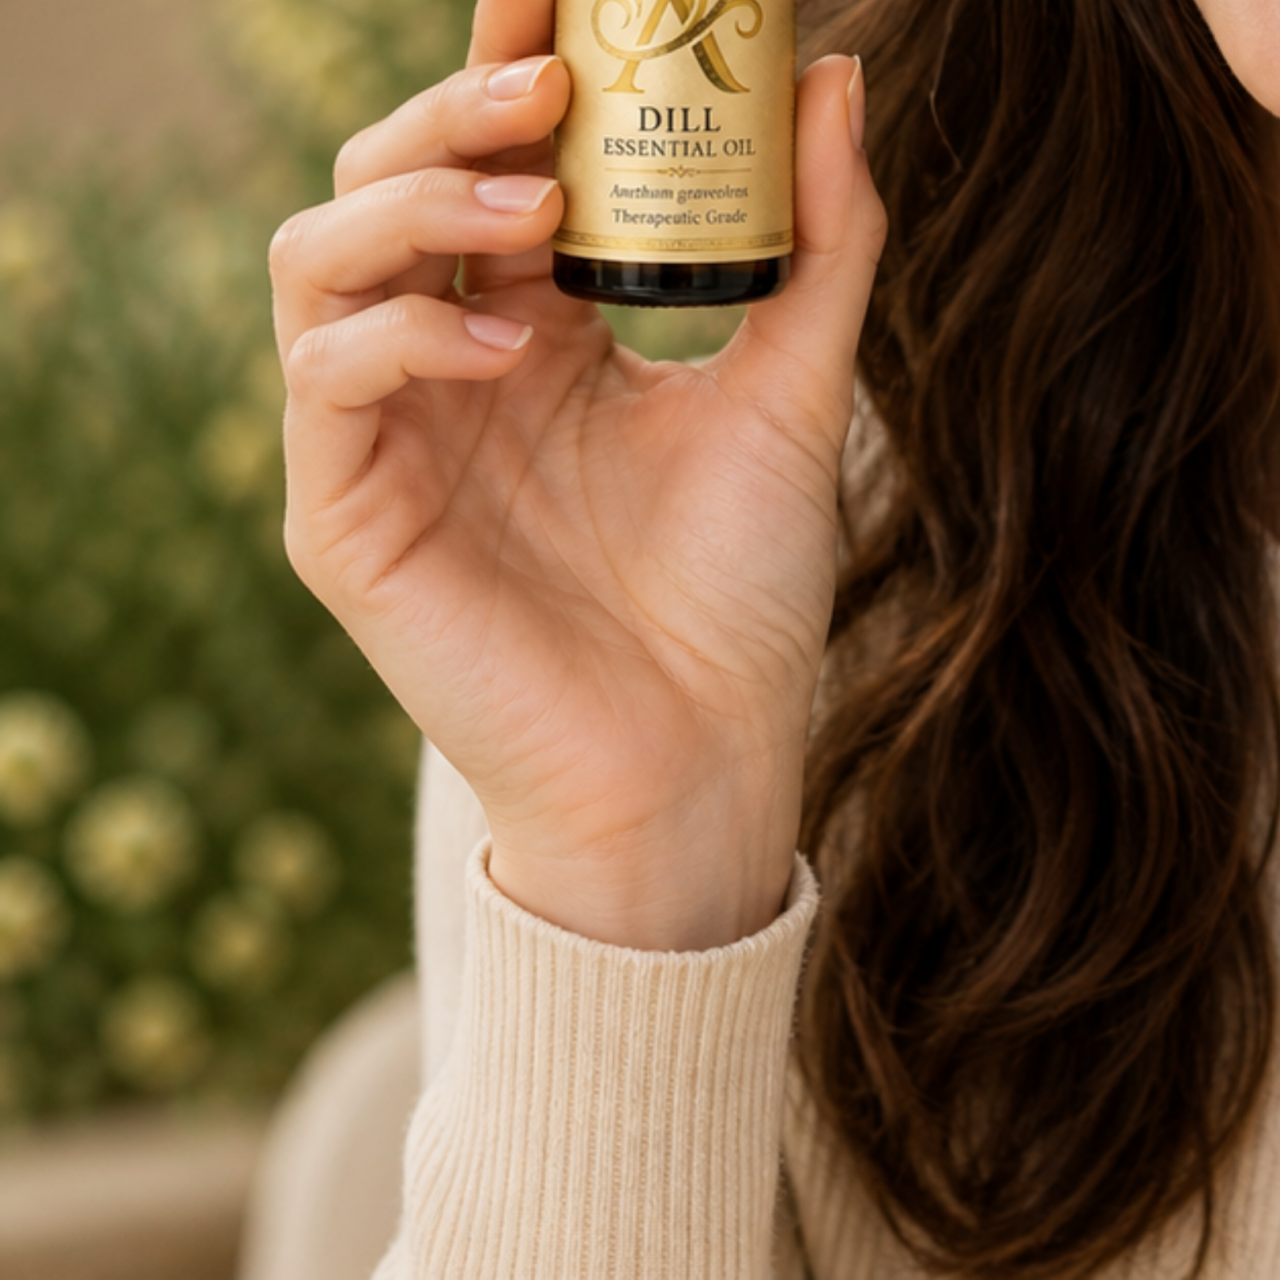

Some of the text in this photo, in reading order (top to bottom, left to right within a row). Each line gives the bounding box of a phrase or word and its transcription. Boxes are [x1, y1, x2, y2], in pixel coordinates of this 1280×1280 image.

[639, 106, 721, 133] DILL
[603, 138, 756, 157] ESSENTIAL OIL
[612, 209, 748, 228] Therapeutic Grade
